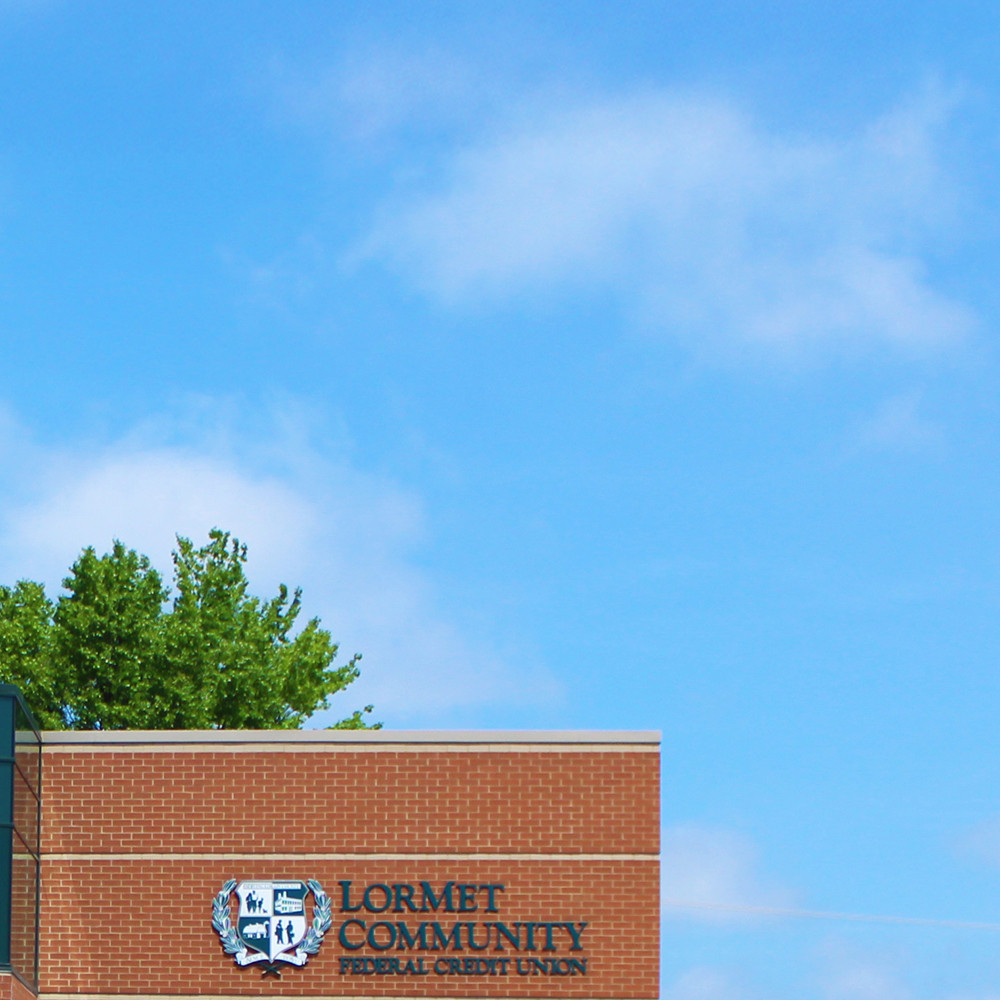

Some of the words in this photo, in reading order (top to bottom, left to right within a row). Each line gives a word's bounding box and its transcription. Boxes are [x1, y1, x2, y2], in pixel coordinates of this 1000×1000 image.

[338, 918, 588, 952] COMMUNITY
[338, 957, 430, 975] FEDERAL
[433, 957, 511, 975] CREDIT
[515, 957, 588, 976] UNION
